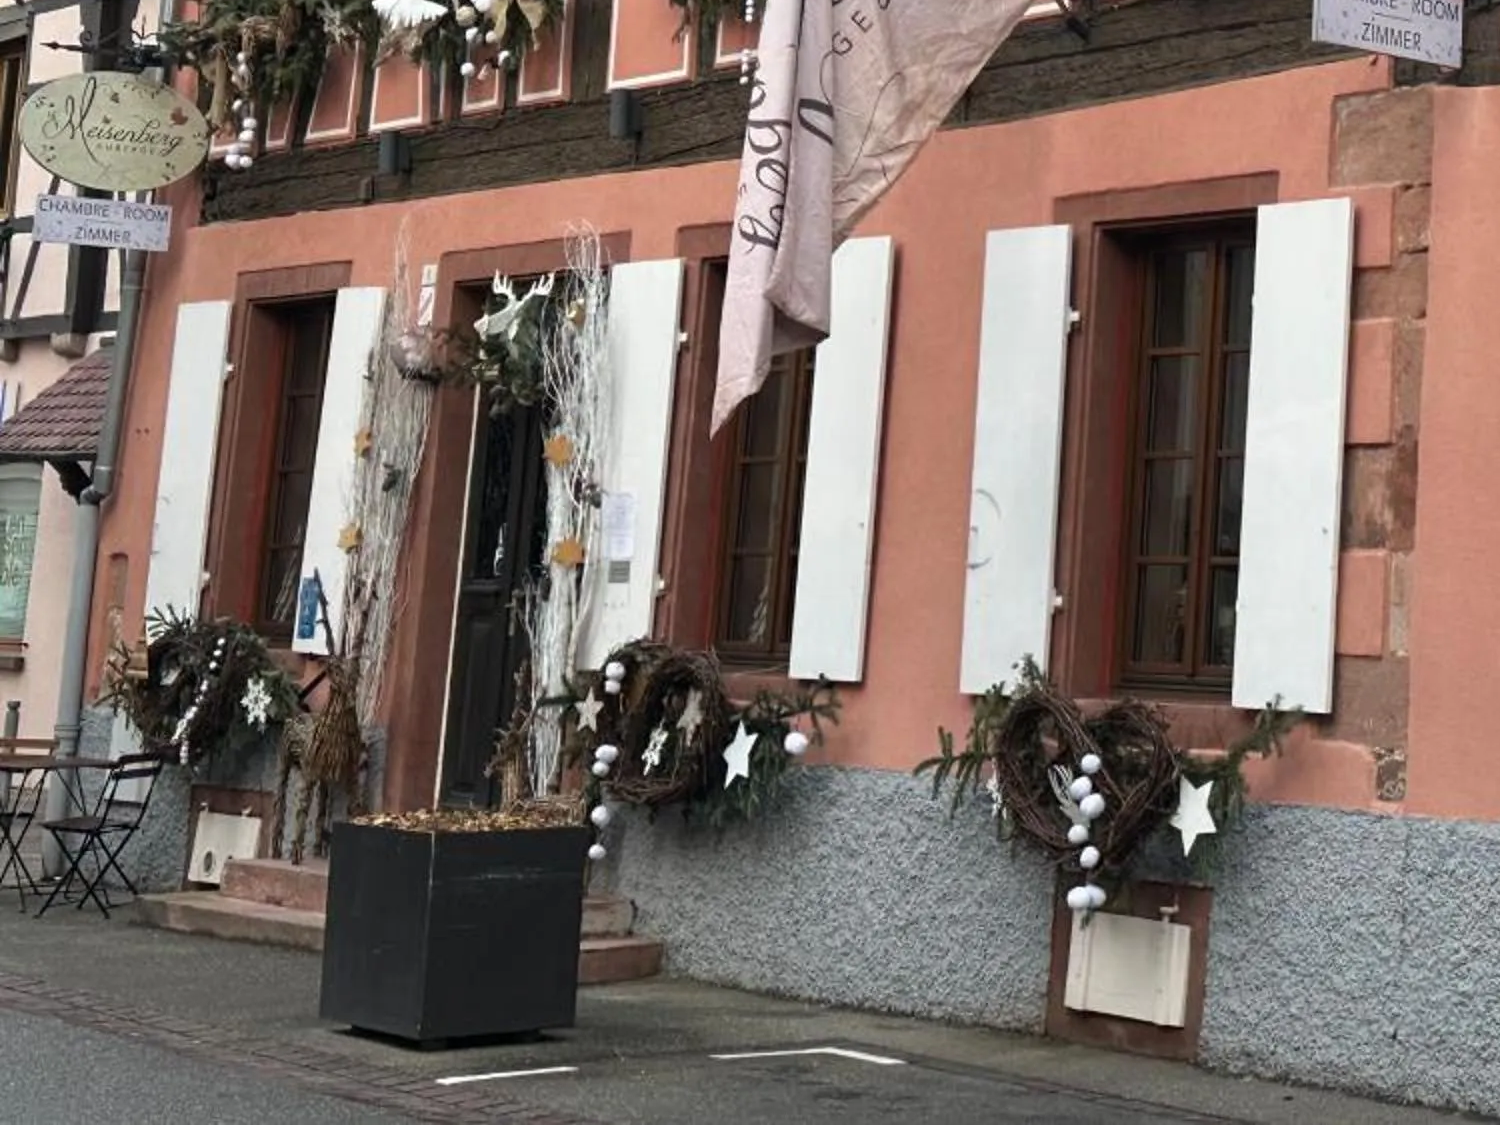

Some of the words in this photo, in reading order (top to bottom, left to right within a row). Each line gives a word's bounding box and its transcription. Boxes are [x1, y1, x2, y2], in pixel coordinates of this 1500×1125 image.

[42, 76, 184, 165] Meisenberg
[39, 198, 110, 218] CHAMBRE
[123, 206, 168, 222] ROOM
